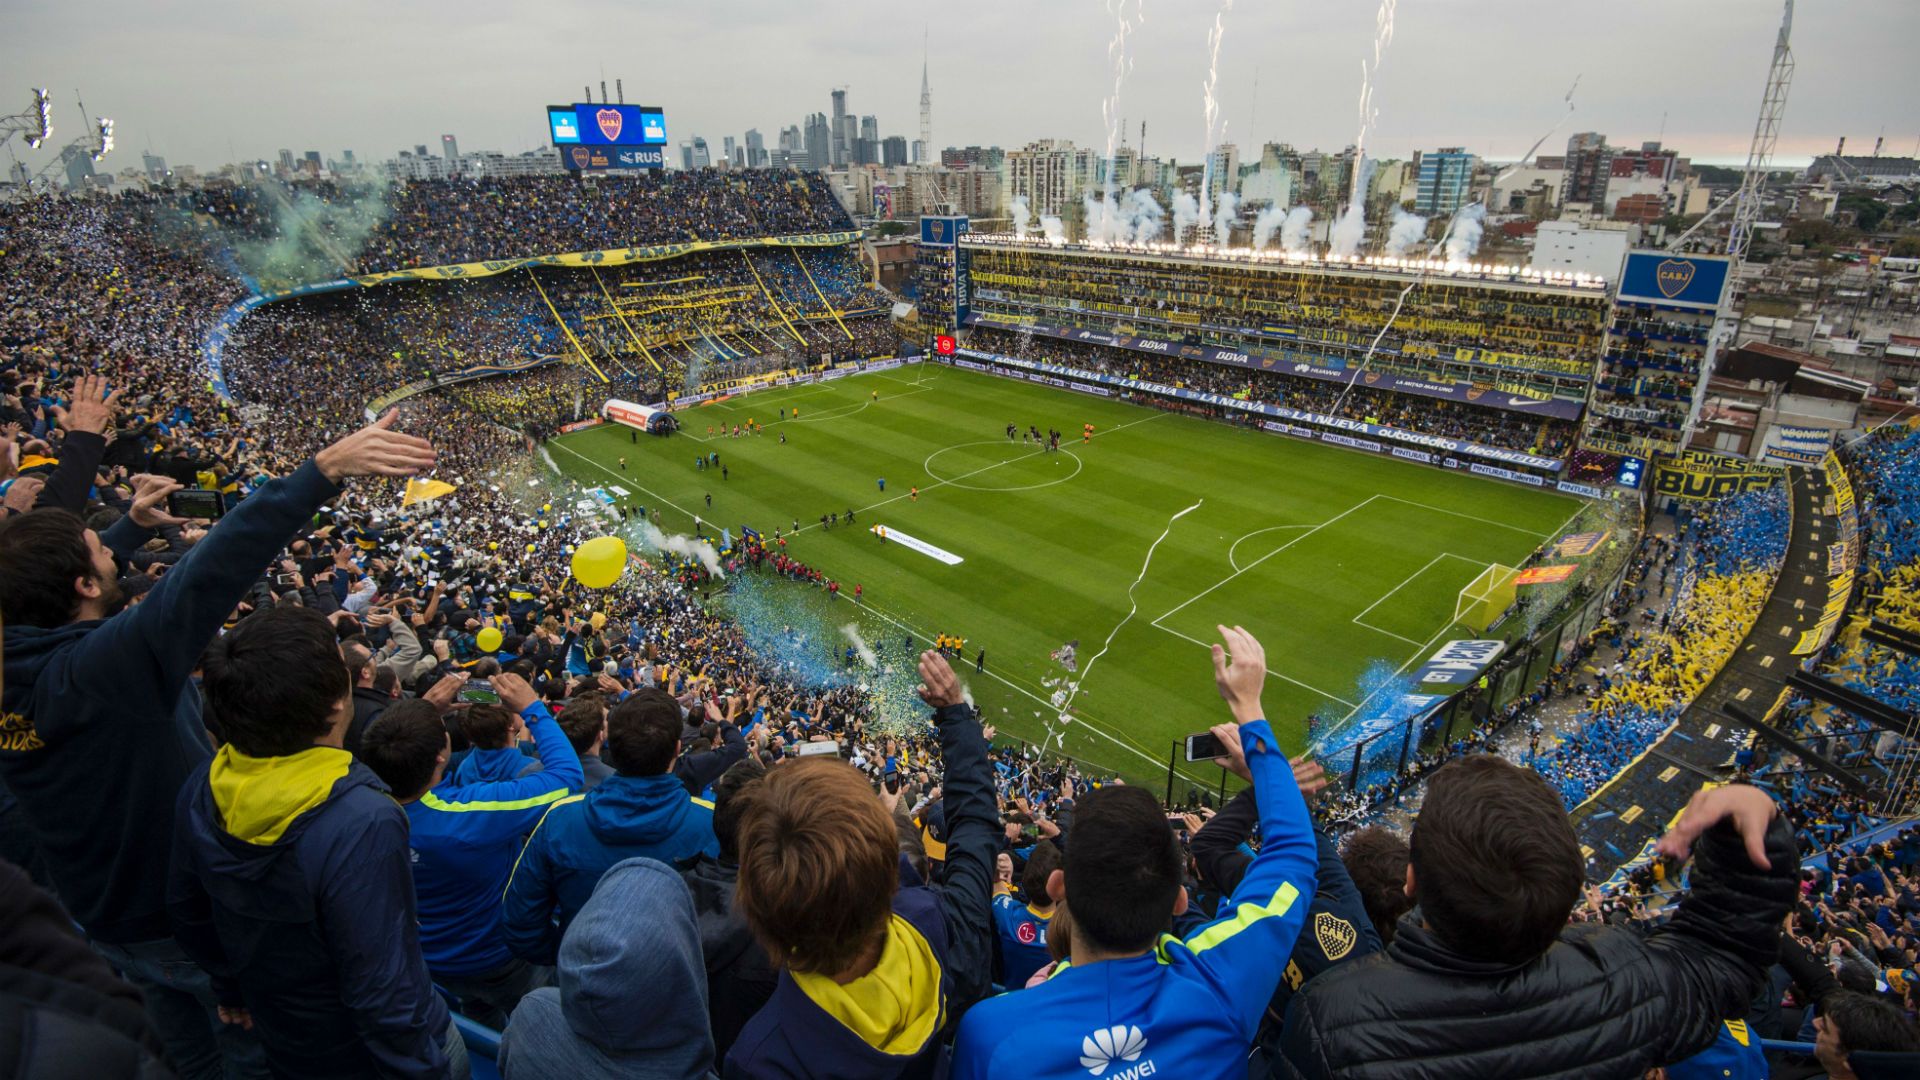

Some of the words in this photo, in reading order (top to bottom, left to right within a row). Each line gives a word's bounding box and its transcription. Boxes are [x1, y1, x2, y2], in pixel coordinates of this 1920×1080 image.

[634, 151, 662, 164] RUS
[1660, 271, 1689, 281] CABJ
[958, 273, 968, 306] BBVA
[1557, 307, 1588, 320] BOCA
[1138, 340, 1168, 351] BBVA
[1215, 351, 1248, 363] BBVA
[1063, 367, 1101, 381] NUEVA
[1310, 367, 1342, 377] HUAWEI
[1119, 378, 1138, 389] LA
[1137, 382, 1178, 396] NUEVA
[1199, 393, 1218, 404] LA
[1217, 397, 1266, 413] NUEVA
[1290, 411, 1313, 423] LA
[1313, 415, 1370, 433] NUEVA
[1323, 434, 1353, 446] PINTURAS
[1353, 439, 1380, 451] Talento
[1584, 439, 1650, 459] PATERNAL
[1394, 449, 1427, 462] PINTURAS
[1681, 450, 1746, 472] FUNES
[1472, 464, 1508, 478] PINTURAS
[1509, 471, 1542, 486] Talento
[1320, 924, 1350, 945] CABJ
